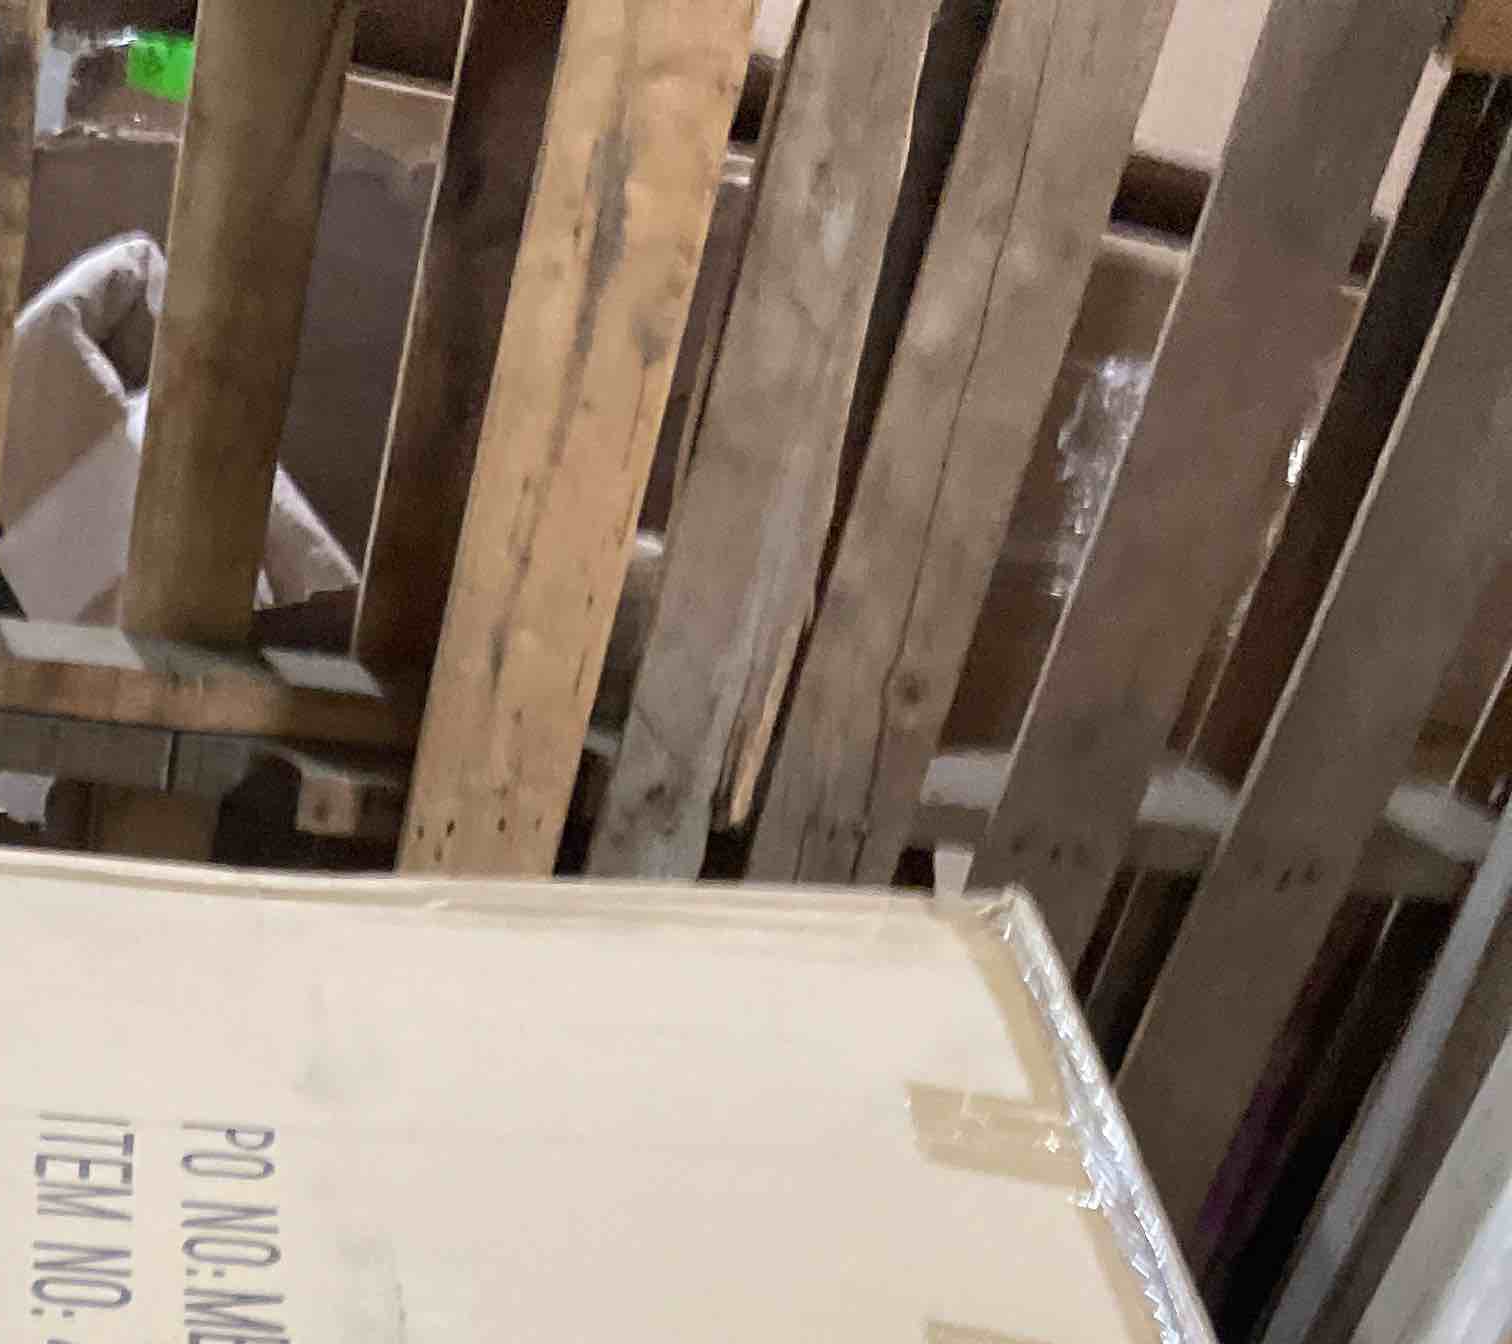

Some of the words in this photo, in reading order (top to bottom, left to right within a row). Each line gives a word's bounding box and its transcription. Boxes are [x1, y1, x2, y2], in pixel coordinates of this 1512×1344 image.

[35, 1112, 134, 1223] ITEM
[181, 1123, 275, 1181] PO
[31, 1242, 133, 1319] NO:
